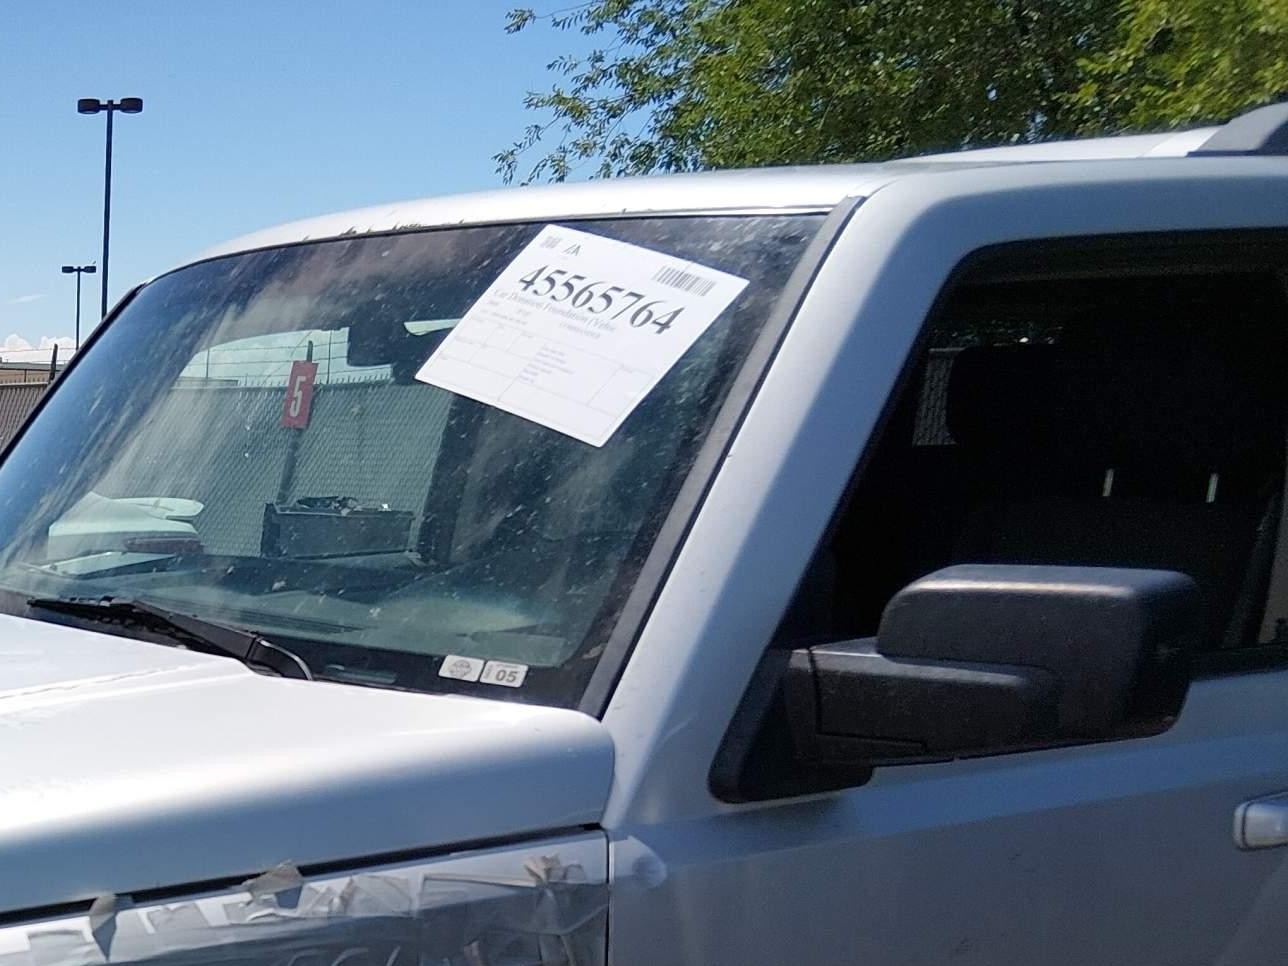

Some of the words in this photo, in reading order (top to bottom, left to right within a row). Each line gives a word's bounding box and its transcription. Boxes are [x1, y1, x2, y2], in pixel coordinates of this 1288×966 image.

[518, 264, 686, 336] 45565764
[289, 375, 307, 418] 5
[495, 668, 520, 684] 05
